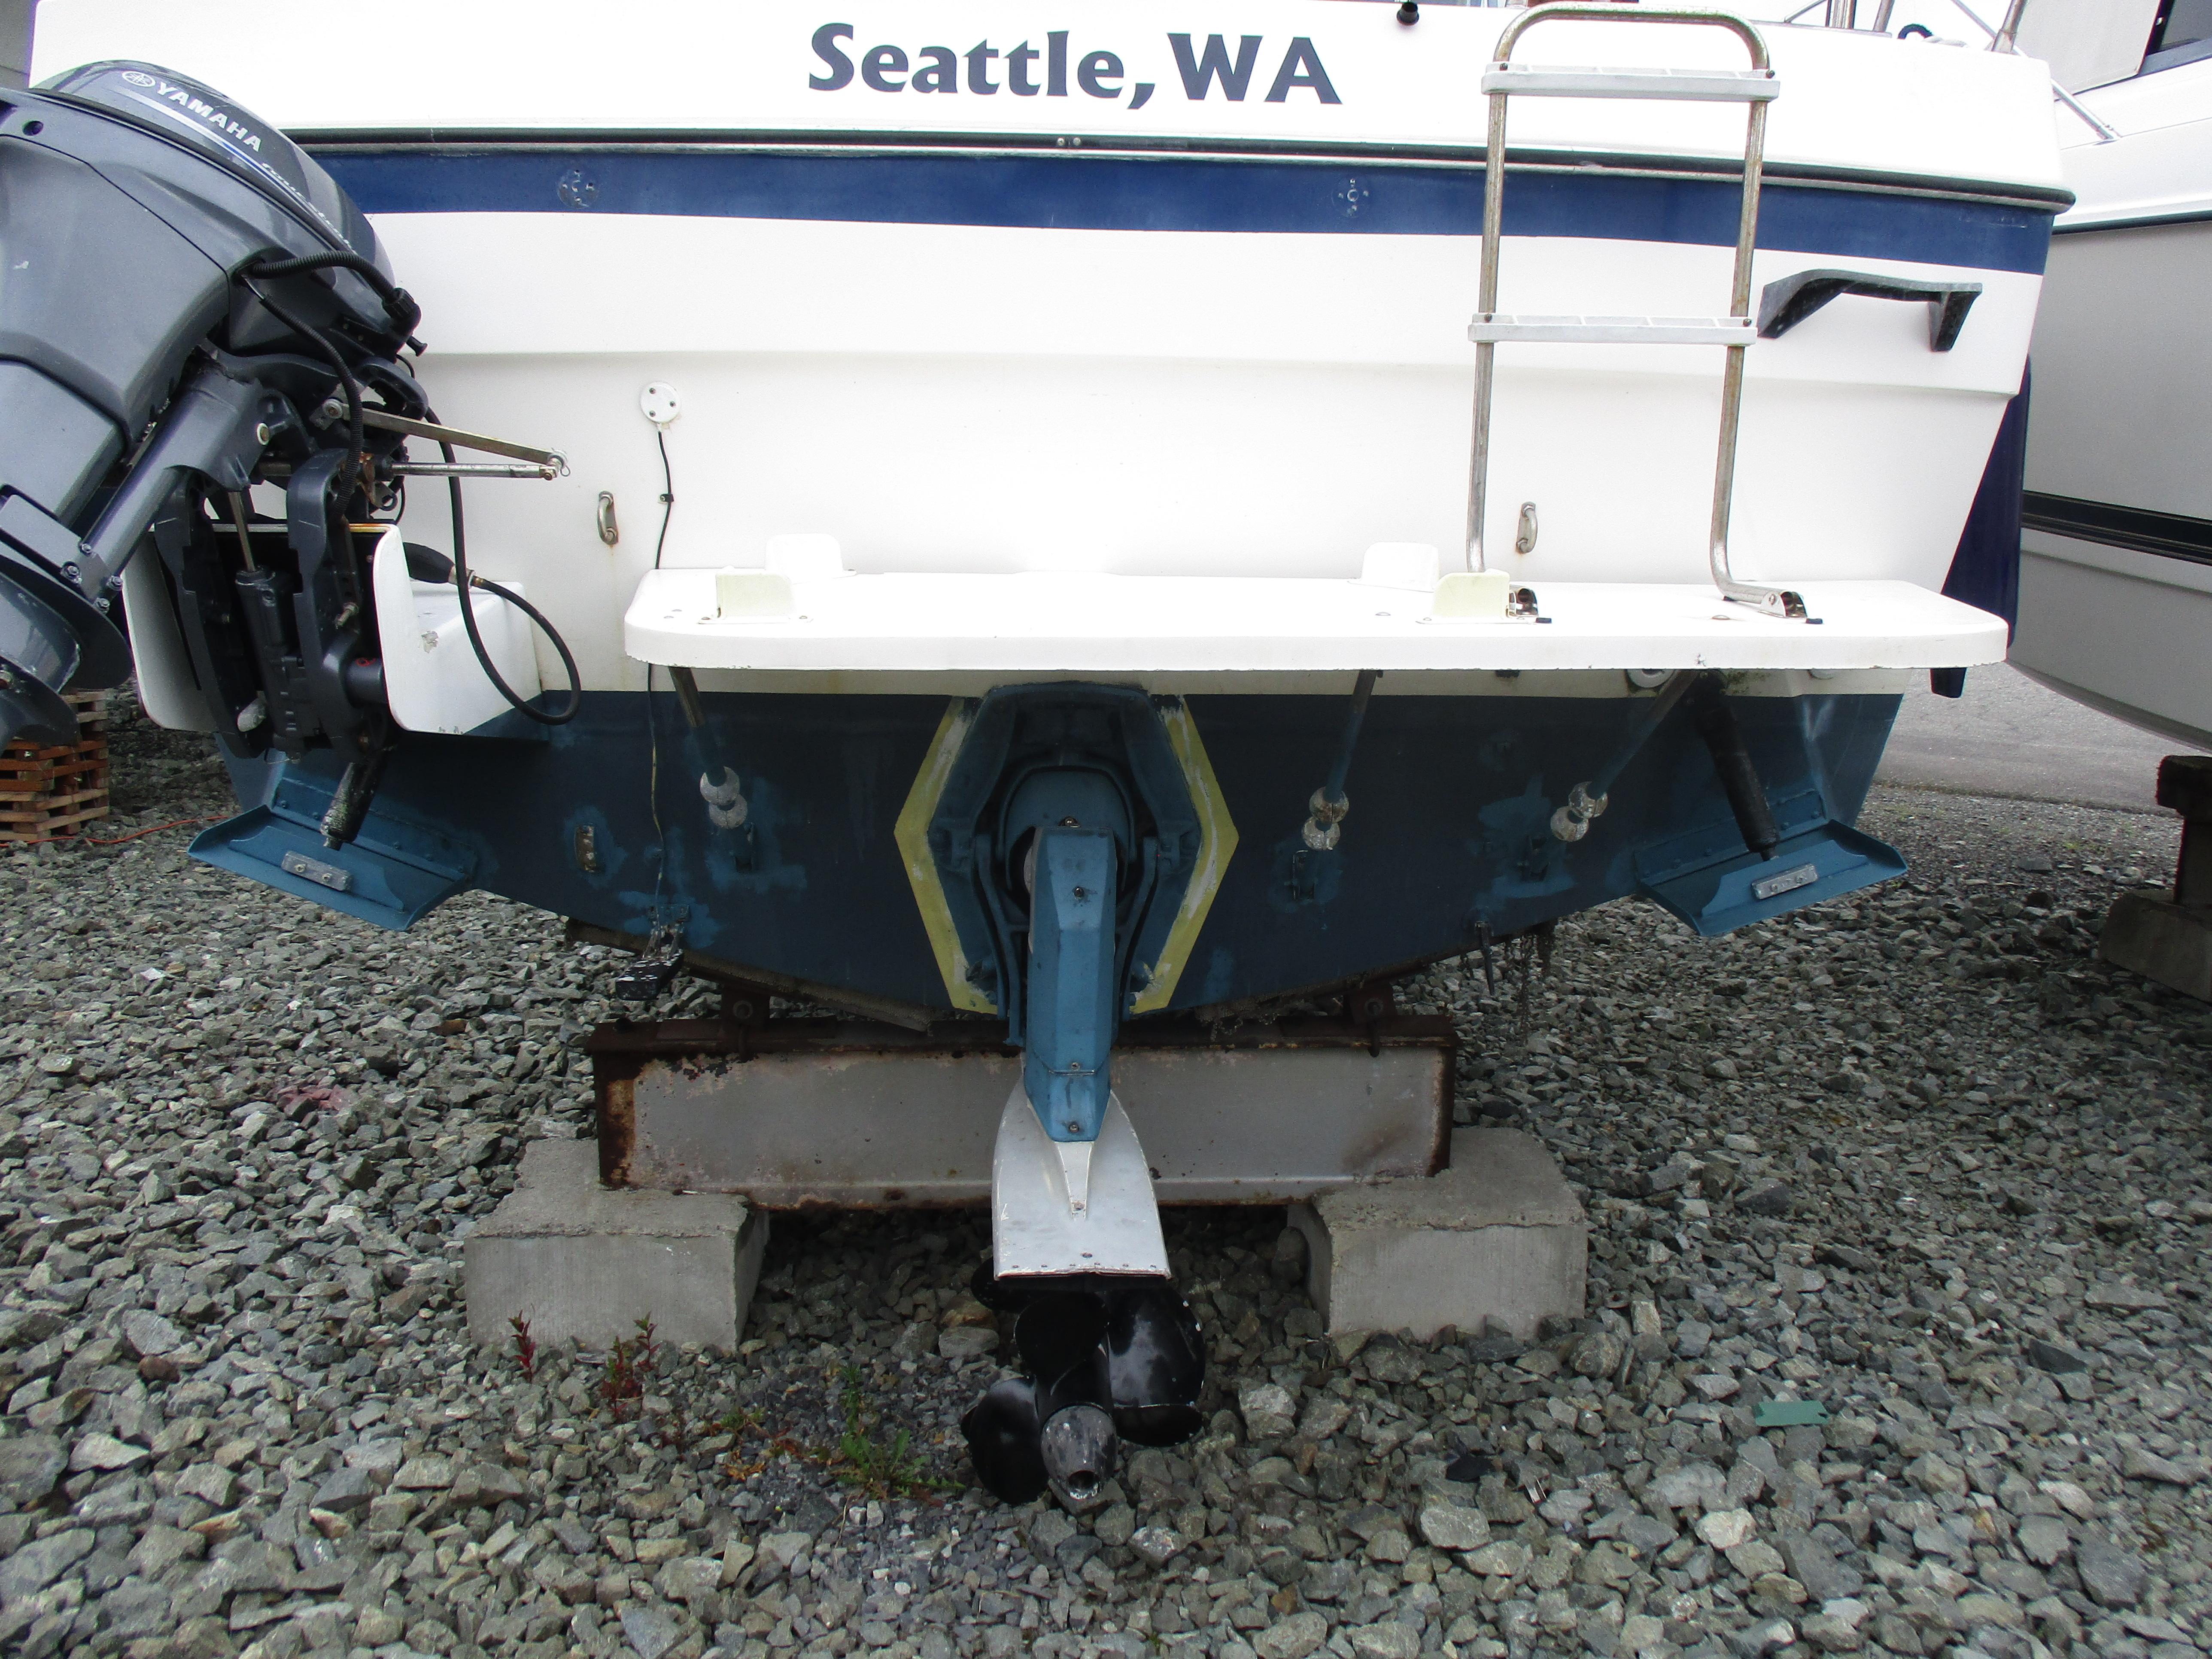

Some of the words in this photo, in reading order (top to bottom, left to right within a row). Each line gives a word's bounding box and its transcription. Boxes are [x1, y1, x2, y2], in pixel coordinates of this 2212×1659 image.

[809, 22, 1156, 109] Seattle,
[1167, 32, 1343, 104] WA
[157, 82, 262, 152] YAMAHA
